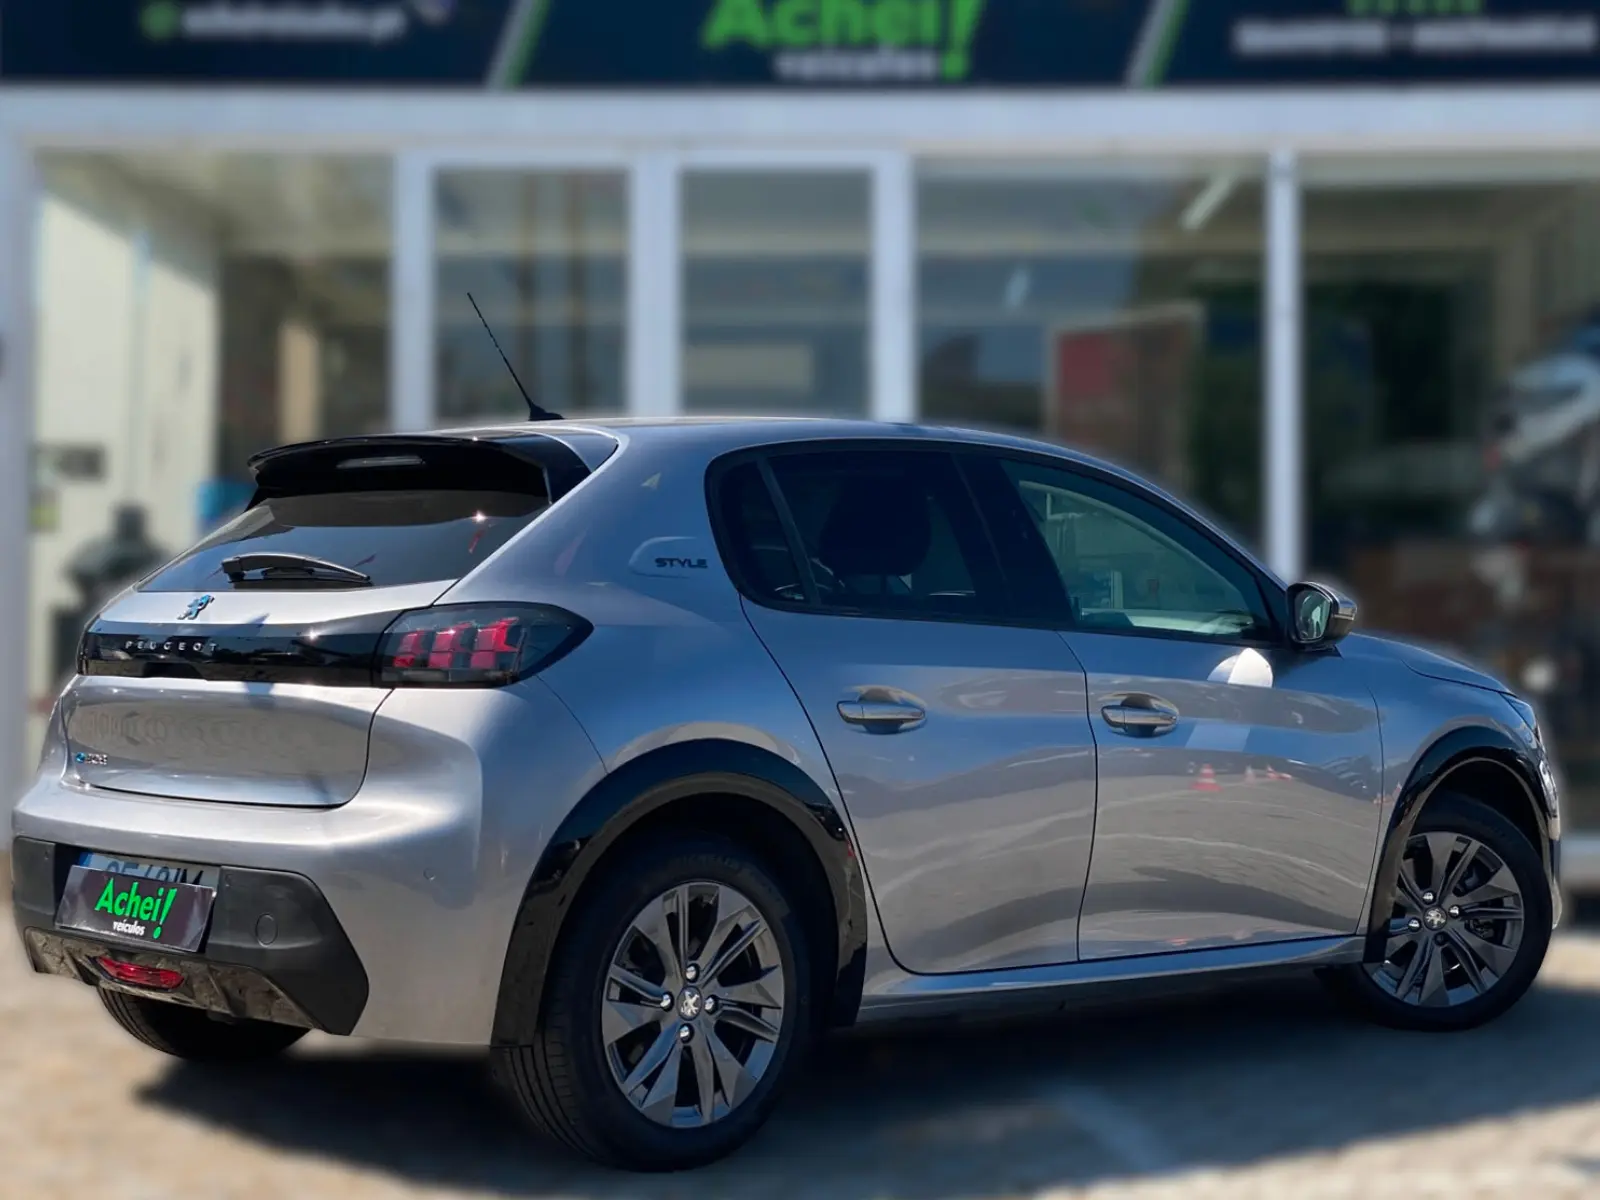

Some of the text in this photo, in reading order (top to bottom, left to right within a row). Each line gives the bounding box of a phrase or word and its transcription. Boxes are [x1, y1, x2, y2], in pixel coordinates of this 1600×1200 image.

[655, 557, 708, 569] STYLE
[125, 640, 217, 651] PEUGEOT
[95, 877, 177, 940] Achei!
